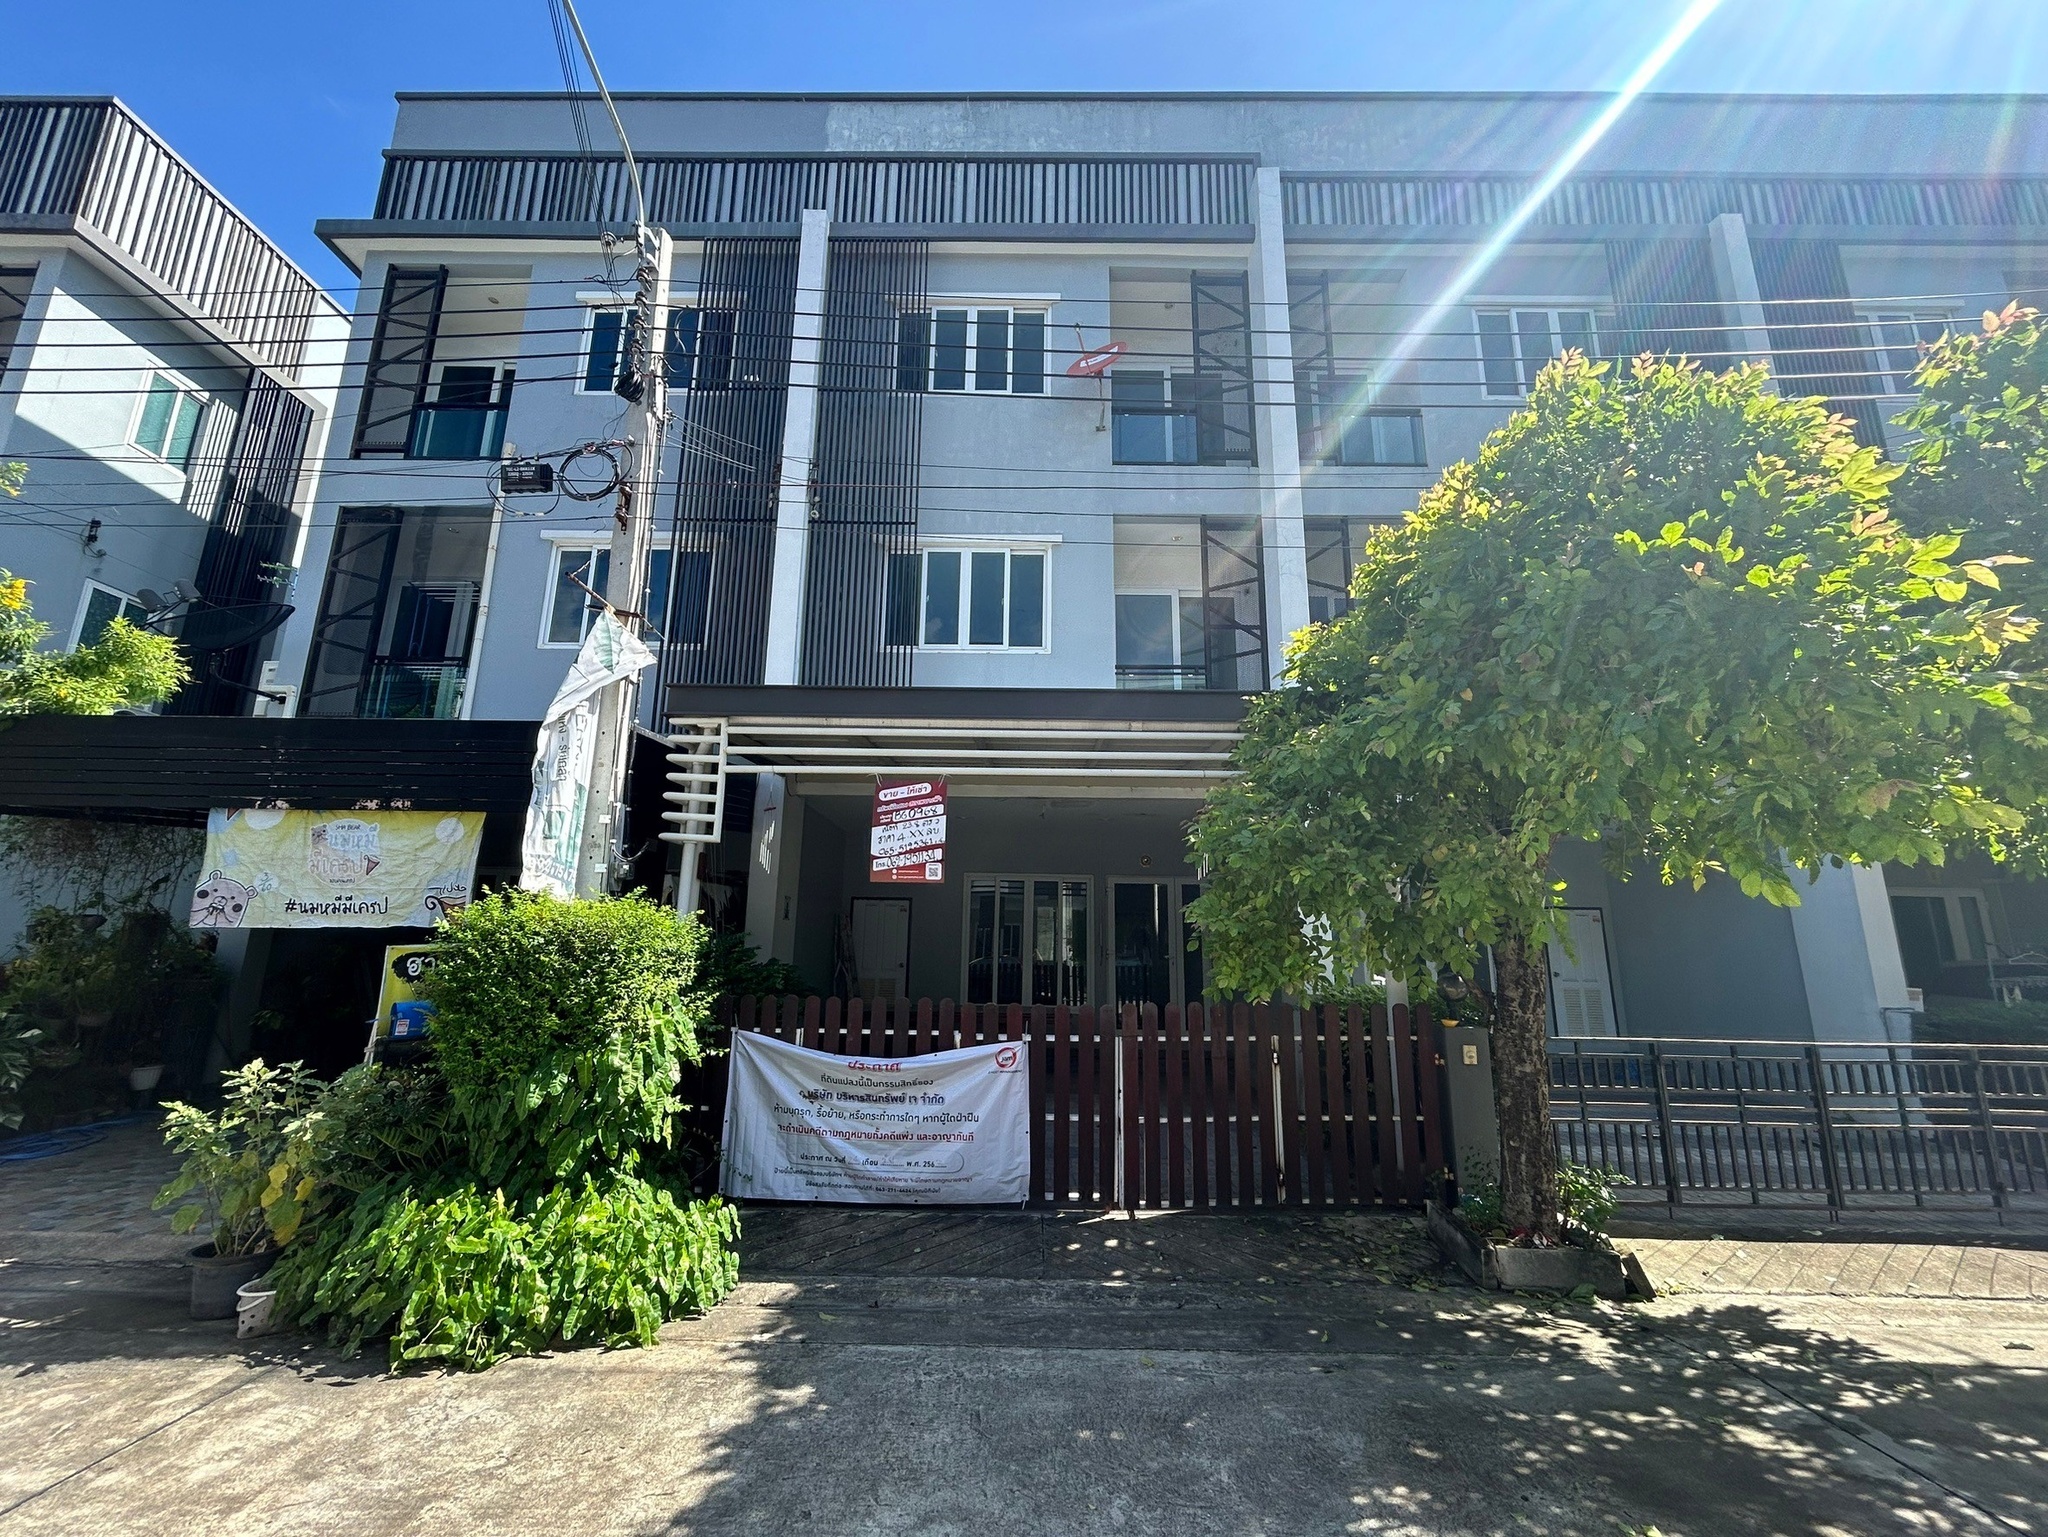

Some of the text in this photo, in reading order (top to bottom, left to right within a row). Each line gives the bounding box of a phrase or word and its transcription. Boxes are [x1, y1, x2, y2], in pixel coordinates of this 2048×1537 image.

[284, 894, 388, 916] #นมหมีมีเครป
[848, 1060, 902, 1073] ประกาศ
[920, 1091, 945, 1105] จำกัด
